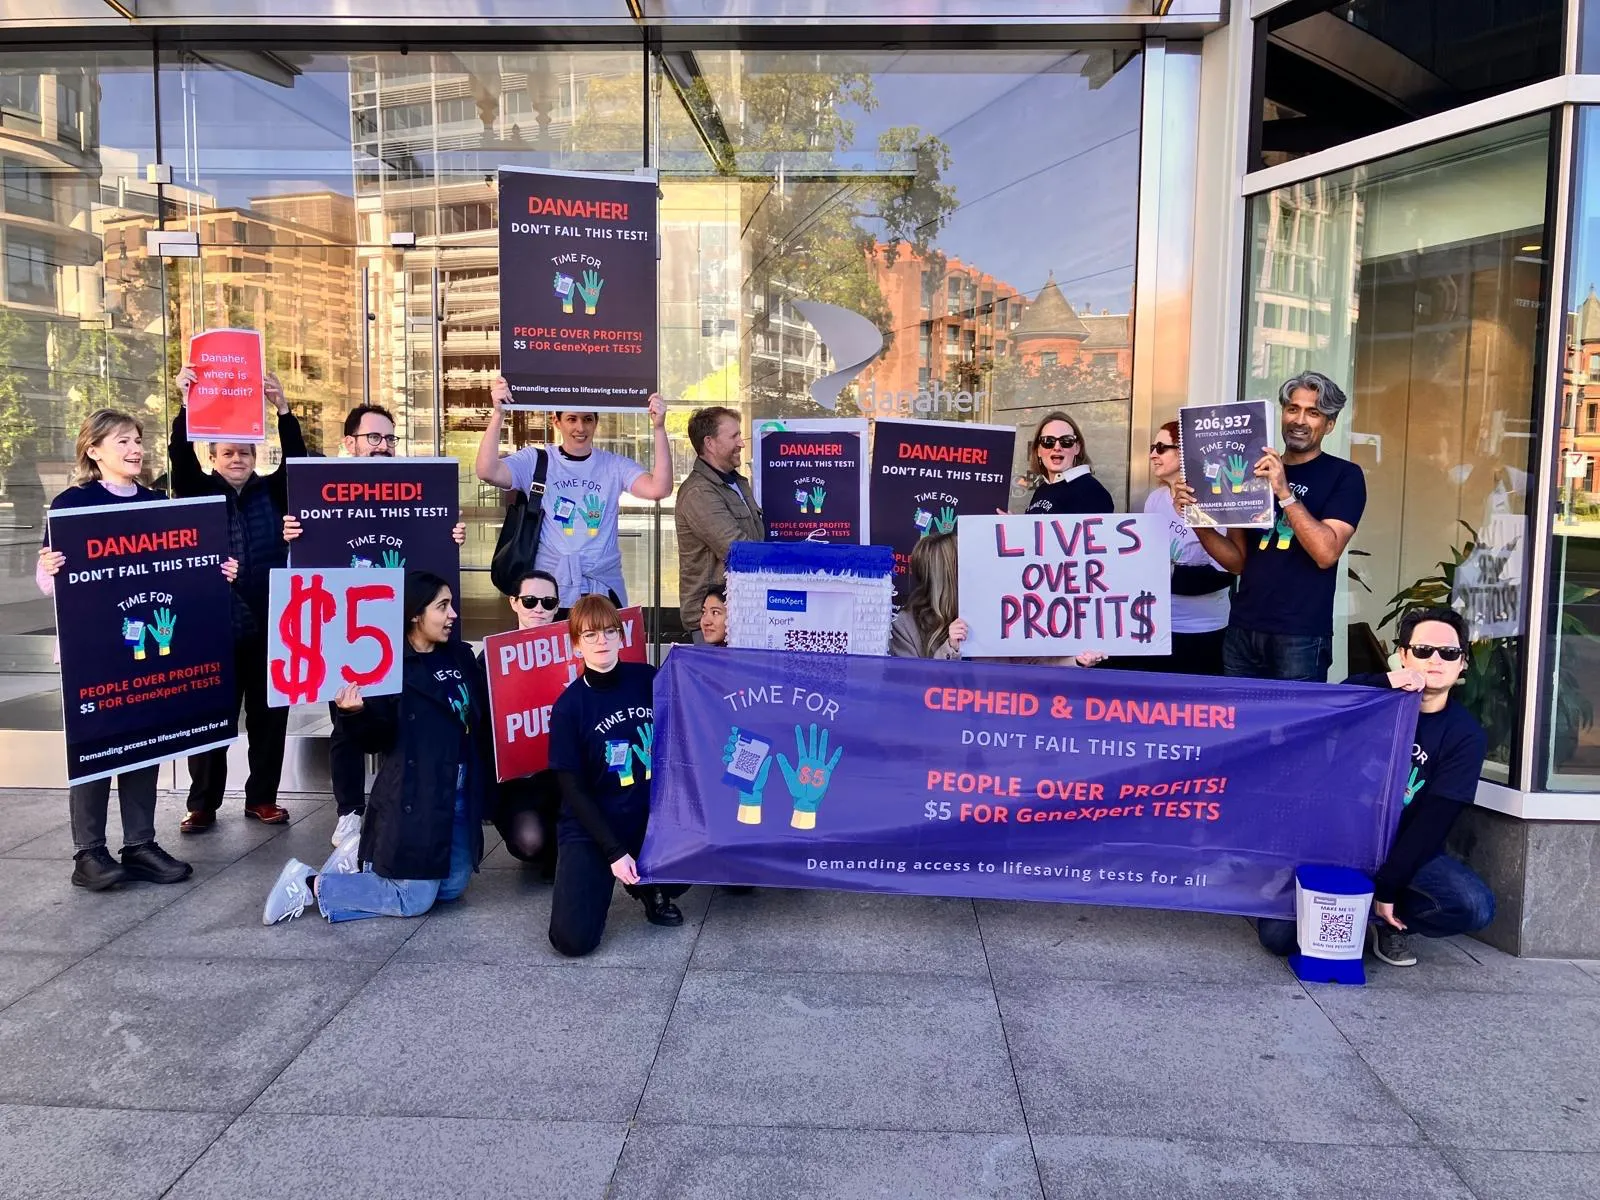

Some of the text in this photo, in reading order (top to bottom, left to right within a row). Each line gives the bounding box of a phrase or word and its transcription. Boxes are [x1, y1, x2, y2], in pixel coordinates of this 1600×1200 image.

[528, 196, 628, 220] DANAHER!
[555, 226, 581, 237] FAIL
[585, 228, 612, 239] THIS
[616, 230, 648, 241] TEST!
[580, 254, 602, 269] FOR
[514, 327, 642, 341] PEOPLE OVER PROFITS!
[513, 340, 642, 354] $5 FOR GeneXpert TESTS
[201, 353, 247, 364] Danaher,
[204, 370, 247, 380] where is
[198, 387, 253, 396] that audit?
[511, 385, 549, 393] Demanding
[580, 386, 611, 395] lifesaving
[856, 378, 986, 413] danaher
[1194, 414, 1250, 431] 206,937
[780, 444, 842, 456] DANAHER!
[898, 443, 988, 464] DANAHER!
[1226, 440, 1246, 452] FOR
[812, 477, 825, 486] FOR
[920, 468, 943, 478] FAIL
[947, 470, 971, 480] THIS
[975, 473, 1003, 483] TEST!
[322, 482, 422, 502] CEPHEID!
[582, 480, 601, 493] FOR
[940, 493, 958, 506] FOR
[348, 508, 376, 518] FAIL
[381, 508, 410, 518] THIS
[414, 507, 448, 517] TEST!
[995, 517, 1142, 557] LIVES
[1169, 520, 1188, 538] FOR
[87, 528, 198, 559] DANAHER!
[379, 534, 403, 549] FOR
[119, 564, 149, 577] FAIL
[153, 559, 183, 573] THIS
[186, 554, 220, 568] TEST!
[1021, 559, 1110, 594] OVER
[150, 592, 173, 605] FOR
[769, 596, 804, 606] GeneXpert
[1001, 590, 1157, 643] PROFIT$
[271, 574, 395, 704] $5
[79, 662, 221, 699] PEOPLE OVER PROFITS!
[80, 676, 221, 714] $5 FOR GeneXpert TESTS
[792, 687, 840, 721] FOR
[628, 707, 653, 718] FOR
[924, 687, 1236, 729] CEPHEID & DANAHER!
[79, 719, 228, 762] Demanding access to lifesaving tests for all
[1035, 735, 1080, 754] FAIL
[1088, 738, 1137, 757] THIS
[1144, 742, 1201, 761] TEST!
[798, 765, 826, 787] $5
[927, 770, 1228, 801] PEOPLE OVER PROFITS!
[924, 800, 1220, 824] $5 FOR GeneXpert TESTS
[807, 857, 1208, 887] Demanding access to lifesaving tests for all
